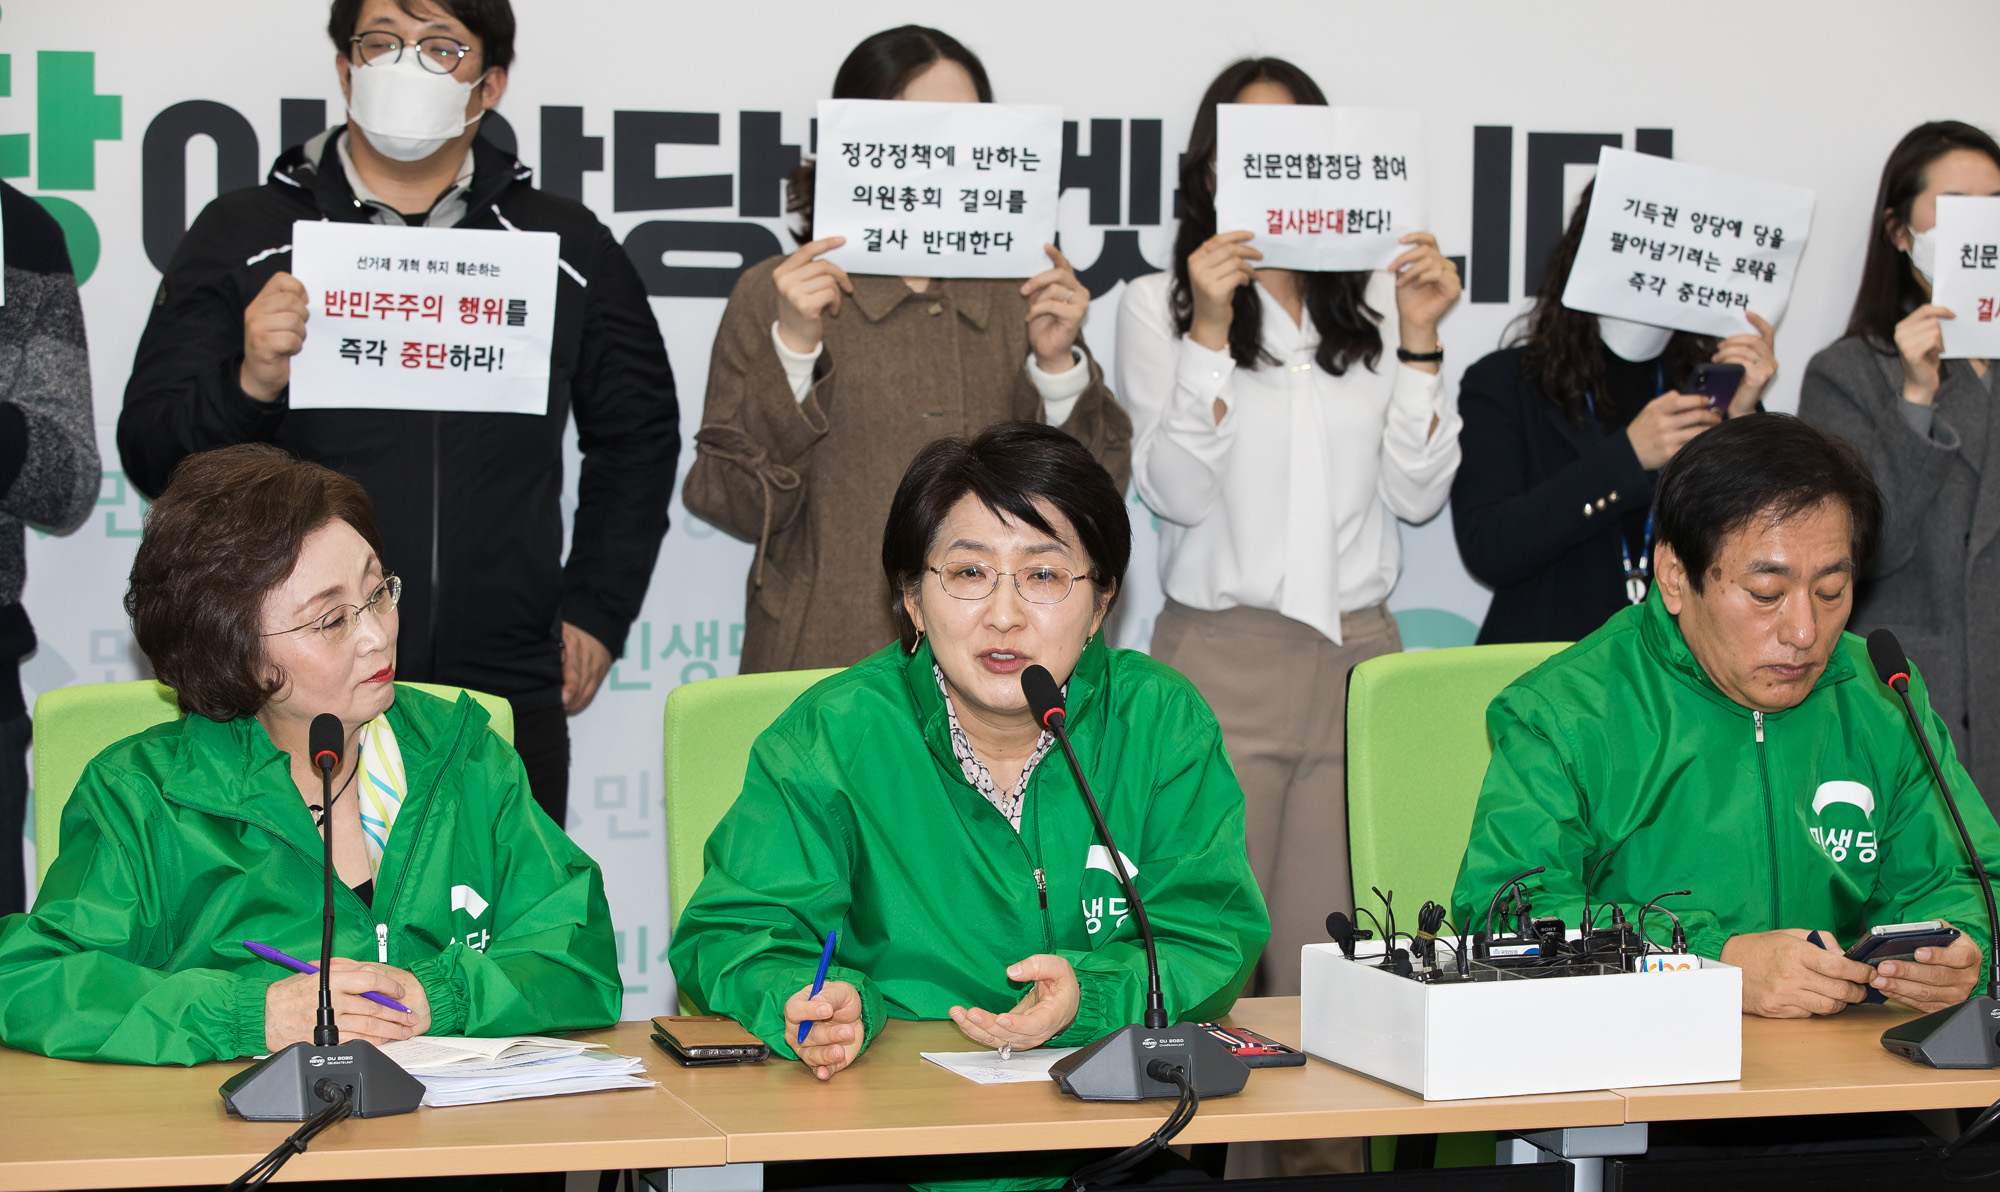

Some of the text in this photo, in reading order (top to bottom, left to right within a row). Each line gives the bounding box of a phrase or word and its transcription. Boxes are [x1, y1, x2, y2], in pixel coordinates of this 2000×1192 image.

[842, 143, 1040, 171] 정강정책에 반하는
[1244, 154, 1406, 180] 친문연합정당 참여
[852, 186, 1027, 213] 의원총회 결의를
[1267, 209, 1390, 234] 결사반대한다!
[1624, 199, 1784, 249] 기득권 양당에 당을
[864, 229, 1013, 255] 결사 반대한다
[358, 257, 500, 277] 선거제 개혁 취지 훼손하는
[1610, 231, 1776, 283] 팔아넘기려는 모략을
[1629, 272, 1749, 310] 즉각 중단하라
[325, 291, 528, 326] 반민주주의 행위를
[339, 338, 503, 372] 즉각 중단하라!
